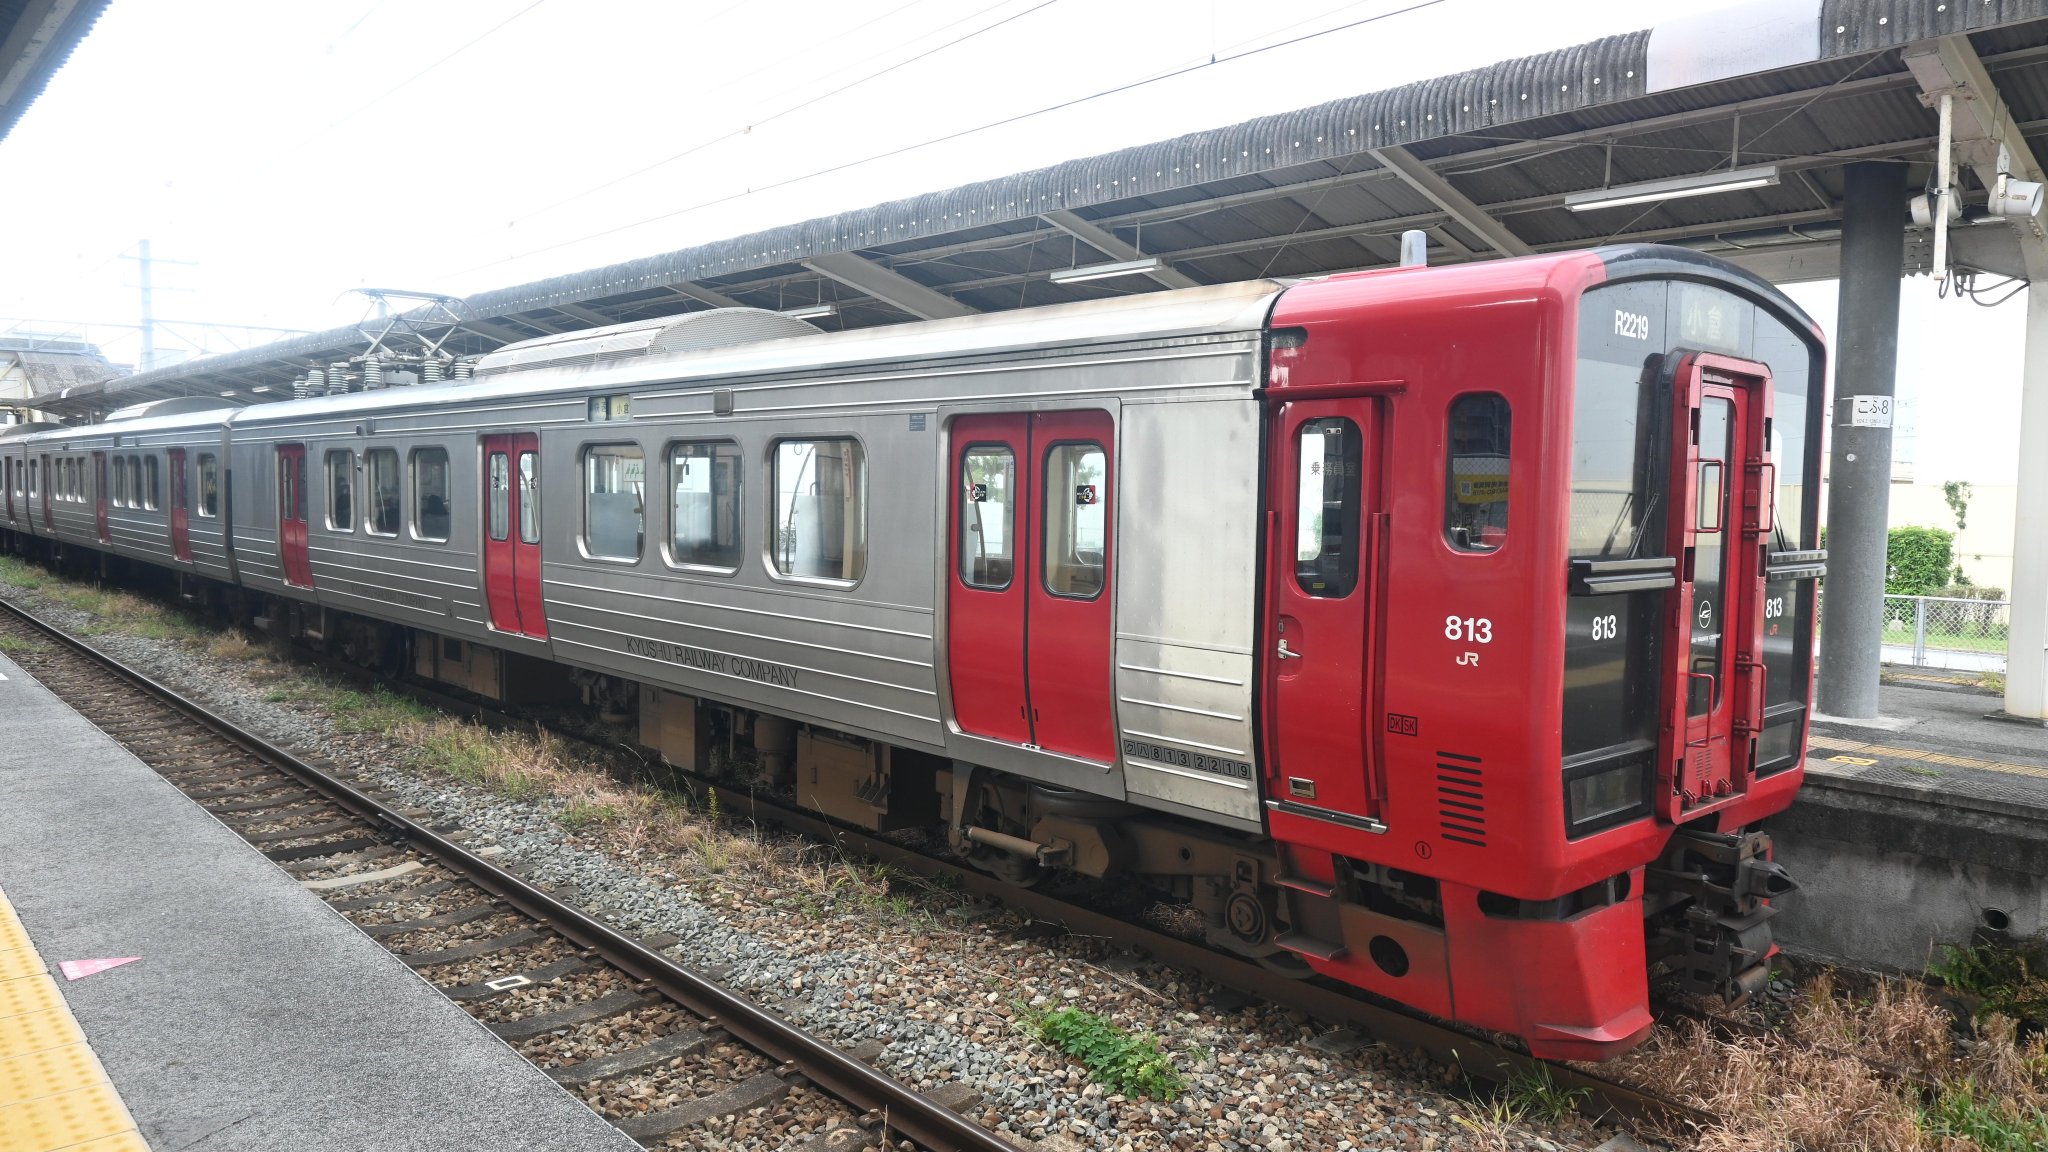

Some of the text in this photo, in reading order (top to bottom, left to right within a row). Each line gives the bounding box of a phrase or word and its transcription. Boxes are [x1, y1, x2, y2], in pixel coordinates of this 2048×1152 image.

[1614, 309, 1649, 341] R2219
[1858, 399, 1889, 415] こふ8
[1310, 461, 1357, 477] 乗務員室
[1766, 597, 1783, 619] 813
[1444, 615, 1493, 644] 813
[1592, 614, 1617, 641] 813
[1769, 623, 1778, 636] JR
[625, 636, 799, 688] KYUSHU RAILWAY COMPANY
[1455, 651, 1480, 667] JR
[1389, 715, 1415, 733] DK SK
